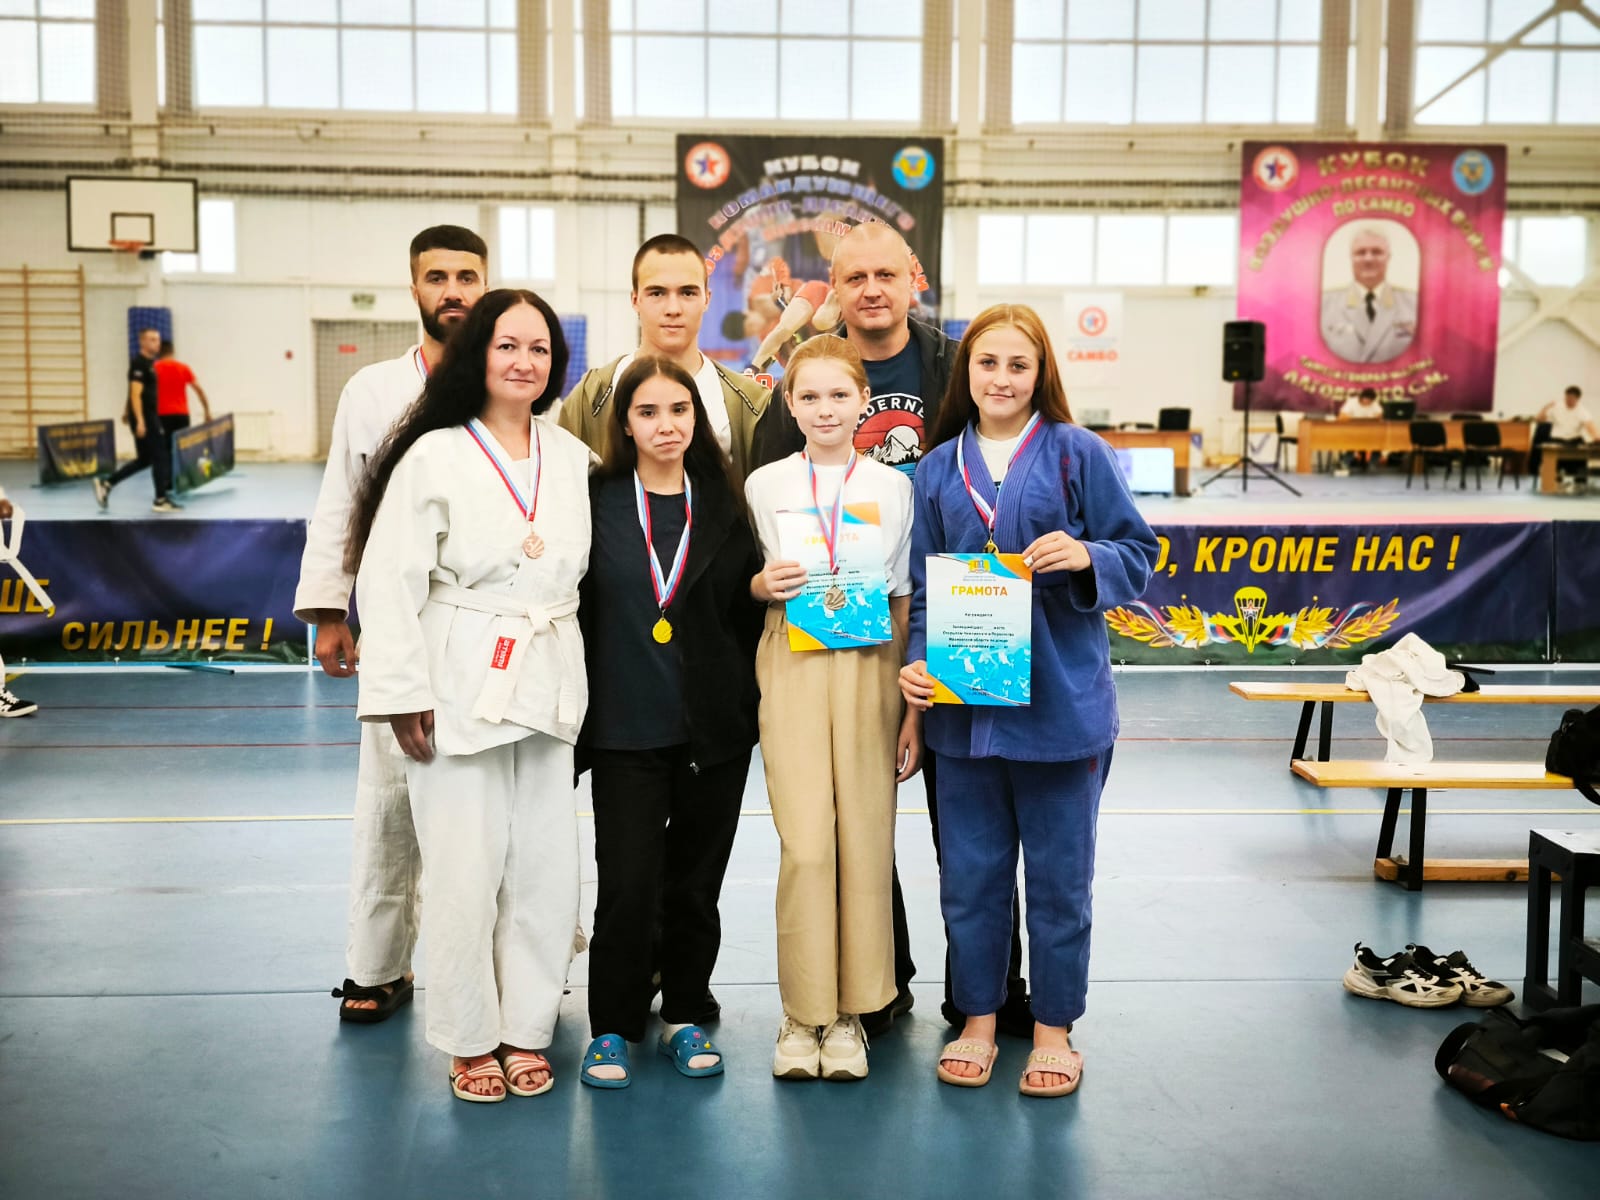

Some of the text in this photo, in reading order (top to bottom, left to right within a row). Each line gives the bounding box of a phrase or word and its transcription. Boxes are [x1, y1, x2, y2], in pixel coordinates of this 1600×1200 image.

[763, 155, 861, 177] КУБОК
[1318, 150, 1429, 177] КУБОК
[1193, 536, 1339, 573] КРОМЕ
[1351, 535, 1434, 572] НАС
[1446, 535, 1460, 571] !
[951, 585, 1008, 596] ГРАМОТА
[61, 617, 273, 651] СИЛЬНЕЕ !
